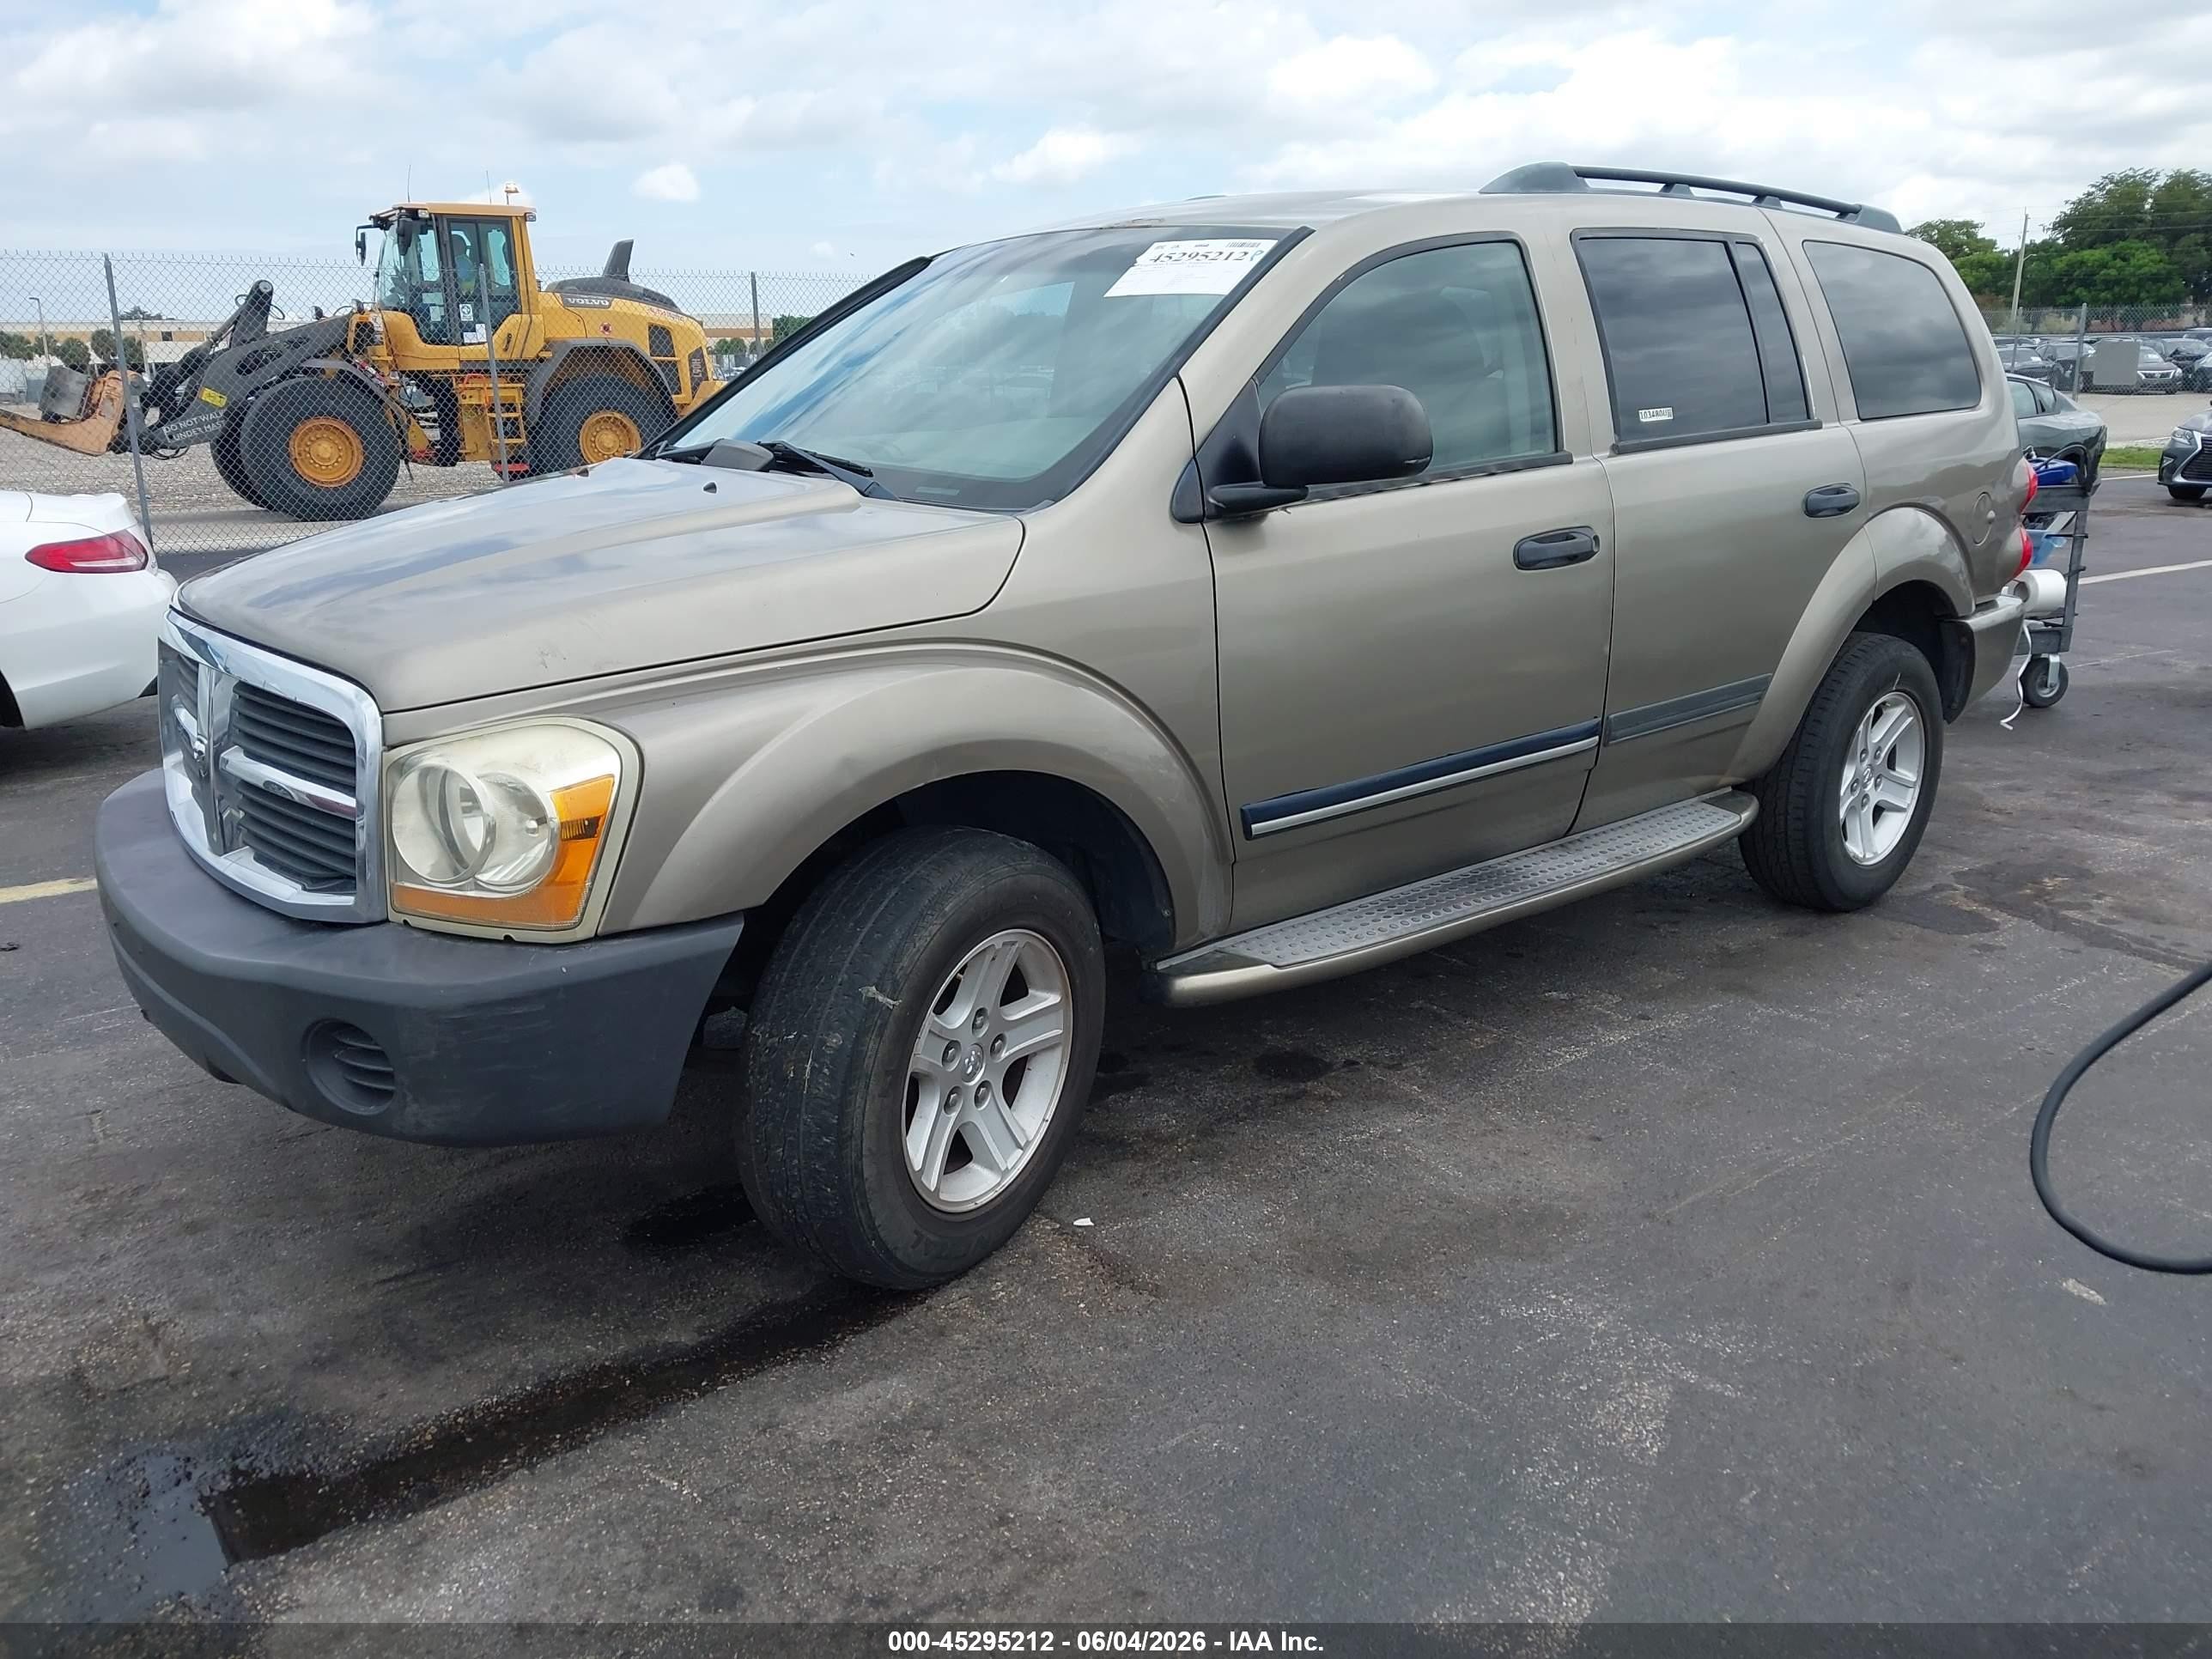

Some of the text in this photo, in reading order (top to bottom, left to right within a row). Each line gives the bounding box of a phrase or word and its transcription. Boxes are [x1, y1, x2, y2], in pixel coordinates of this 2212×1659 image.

[1149, 251, 1249, 263] 45295212
[567, 297, 609, 306] VOLVO
[163, 424, 178, 434] DO
[179, 417, 198, 428] NOT
[173, 427, 204, 441] UNDER
